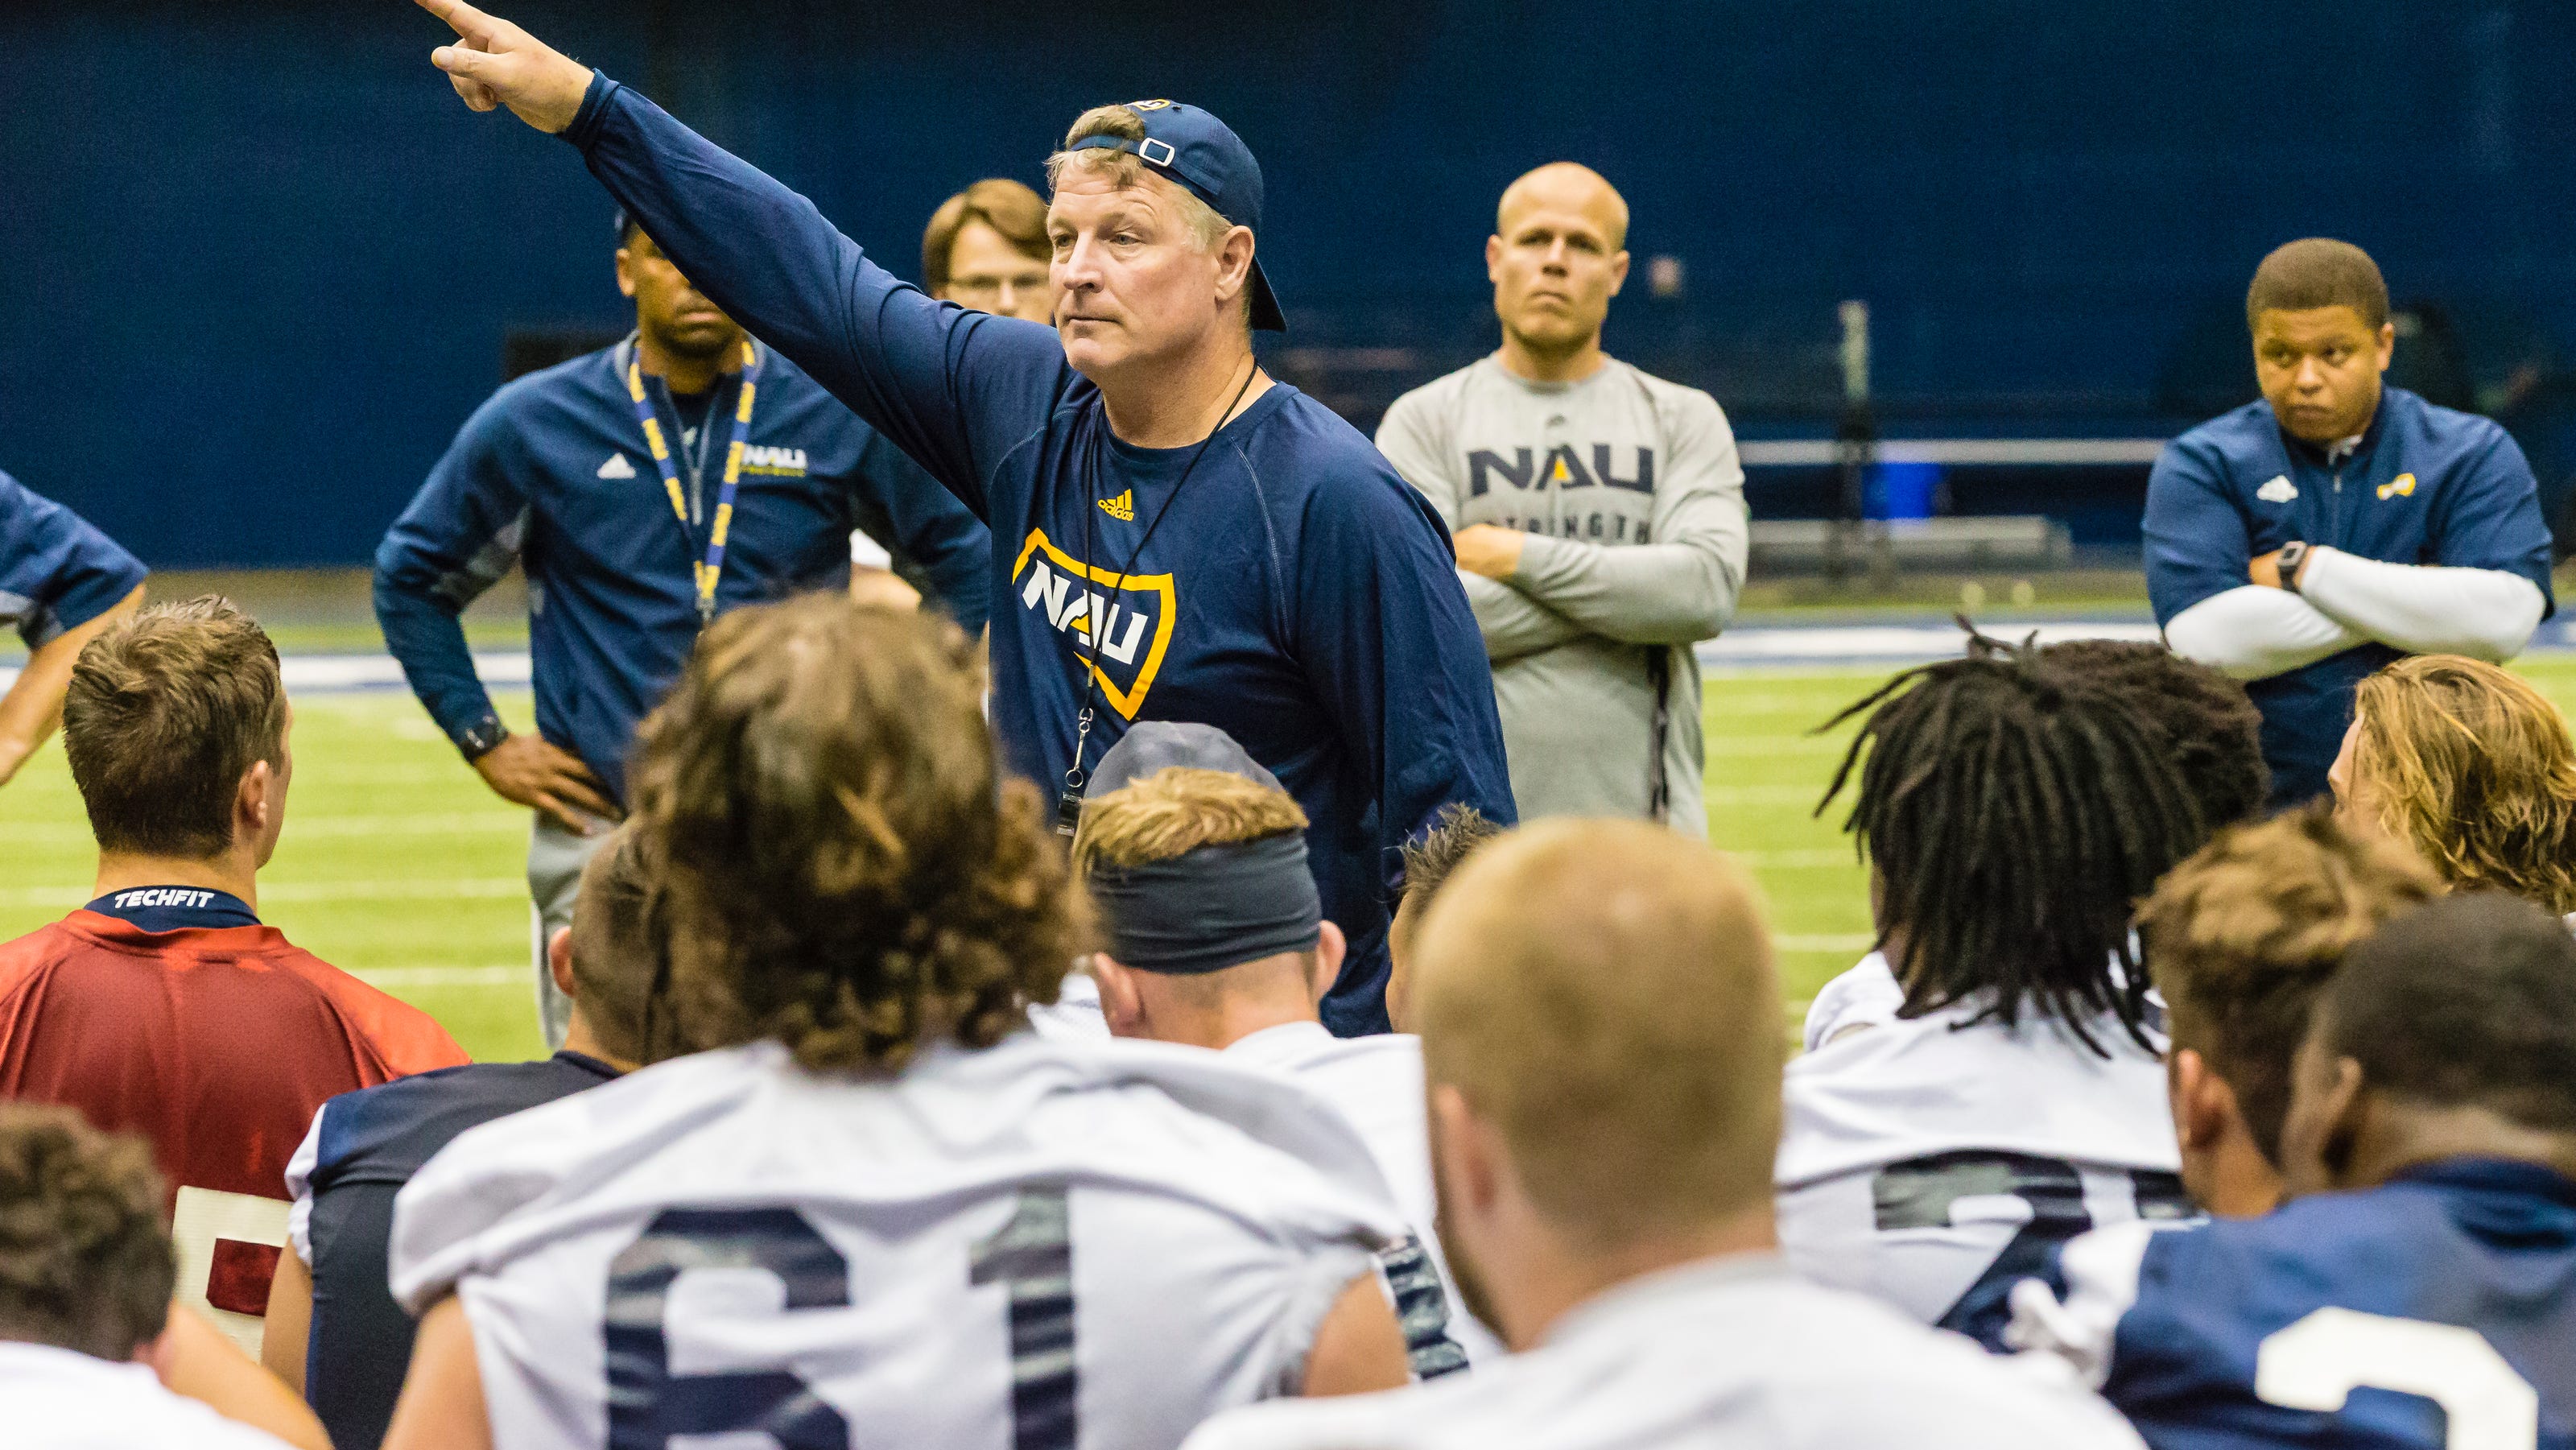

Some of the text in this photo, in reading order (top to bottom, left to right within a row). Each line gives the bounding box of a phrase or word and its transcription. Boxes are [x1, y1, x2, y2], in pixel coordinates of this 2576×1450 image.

[1468, 444, 1656, 497] NAU
[1097, 499, 1135, 522] adidas
[1484, 511, 1652, 545] TRNGTH
[1022, 559, 1149, 666] NAU
[114, 889, 215, 909] TECHFIT
[601, 1186, 1080, 1450] 61
